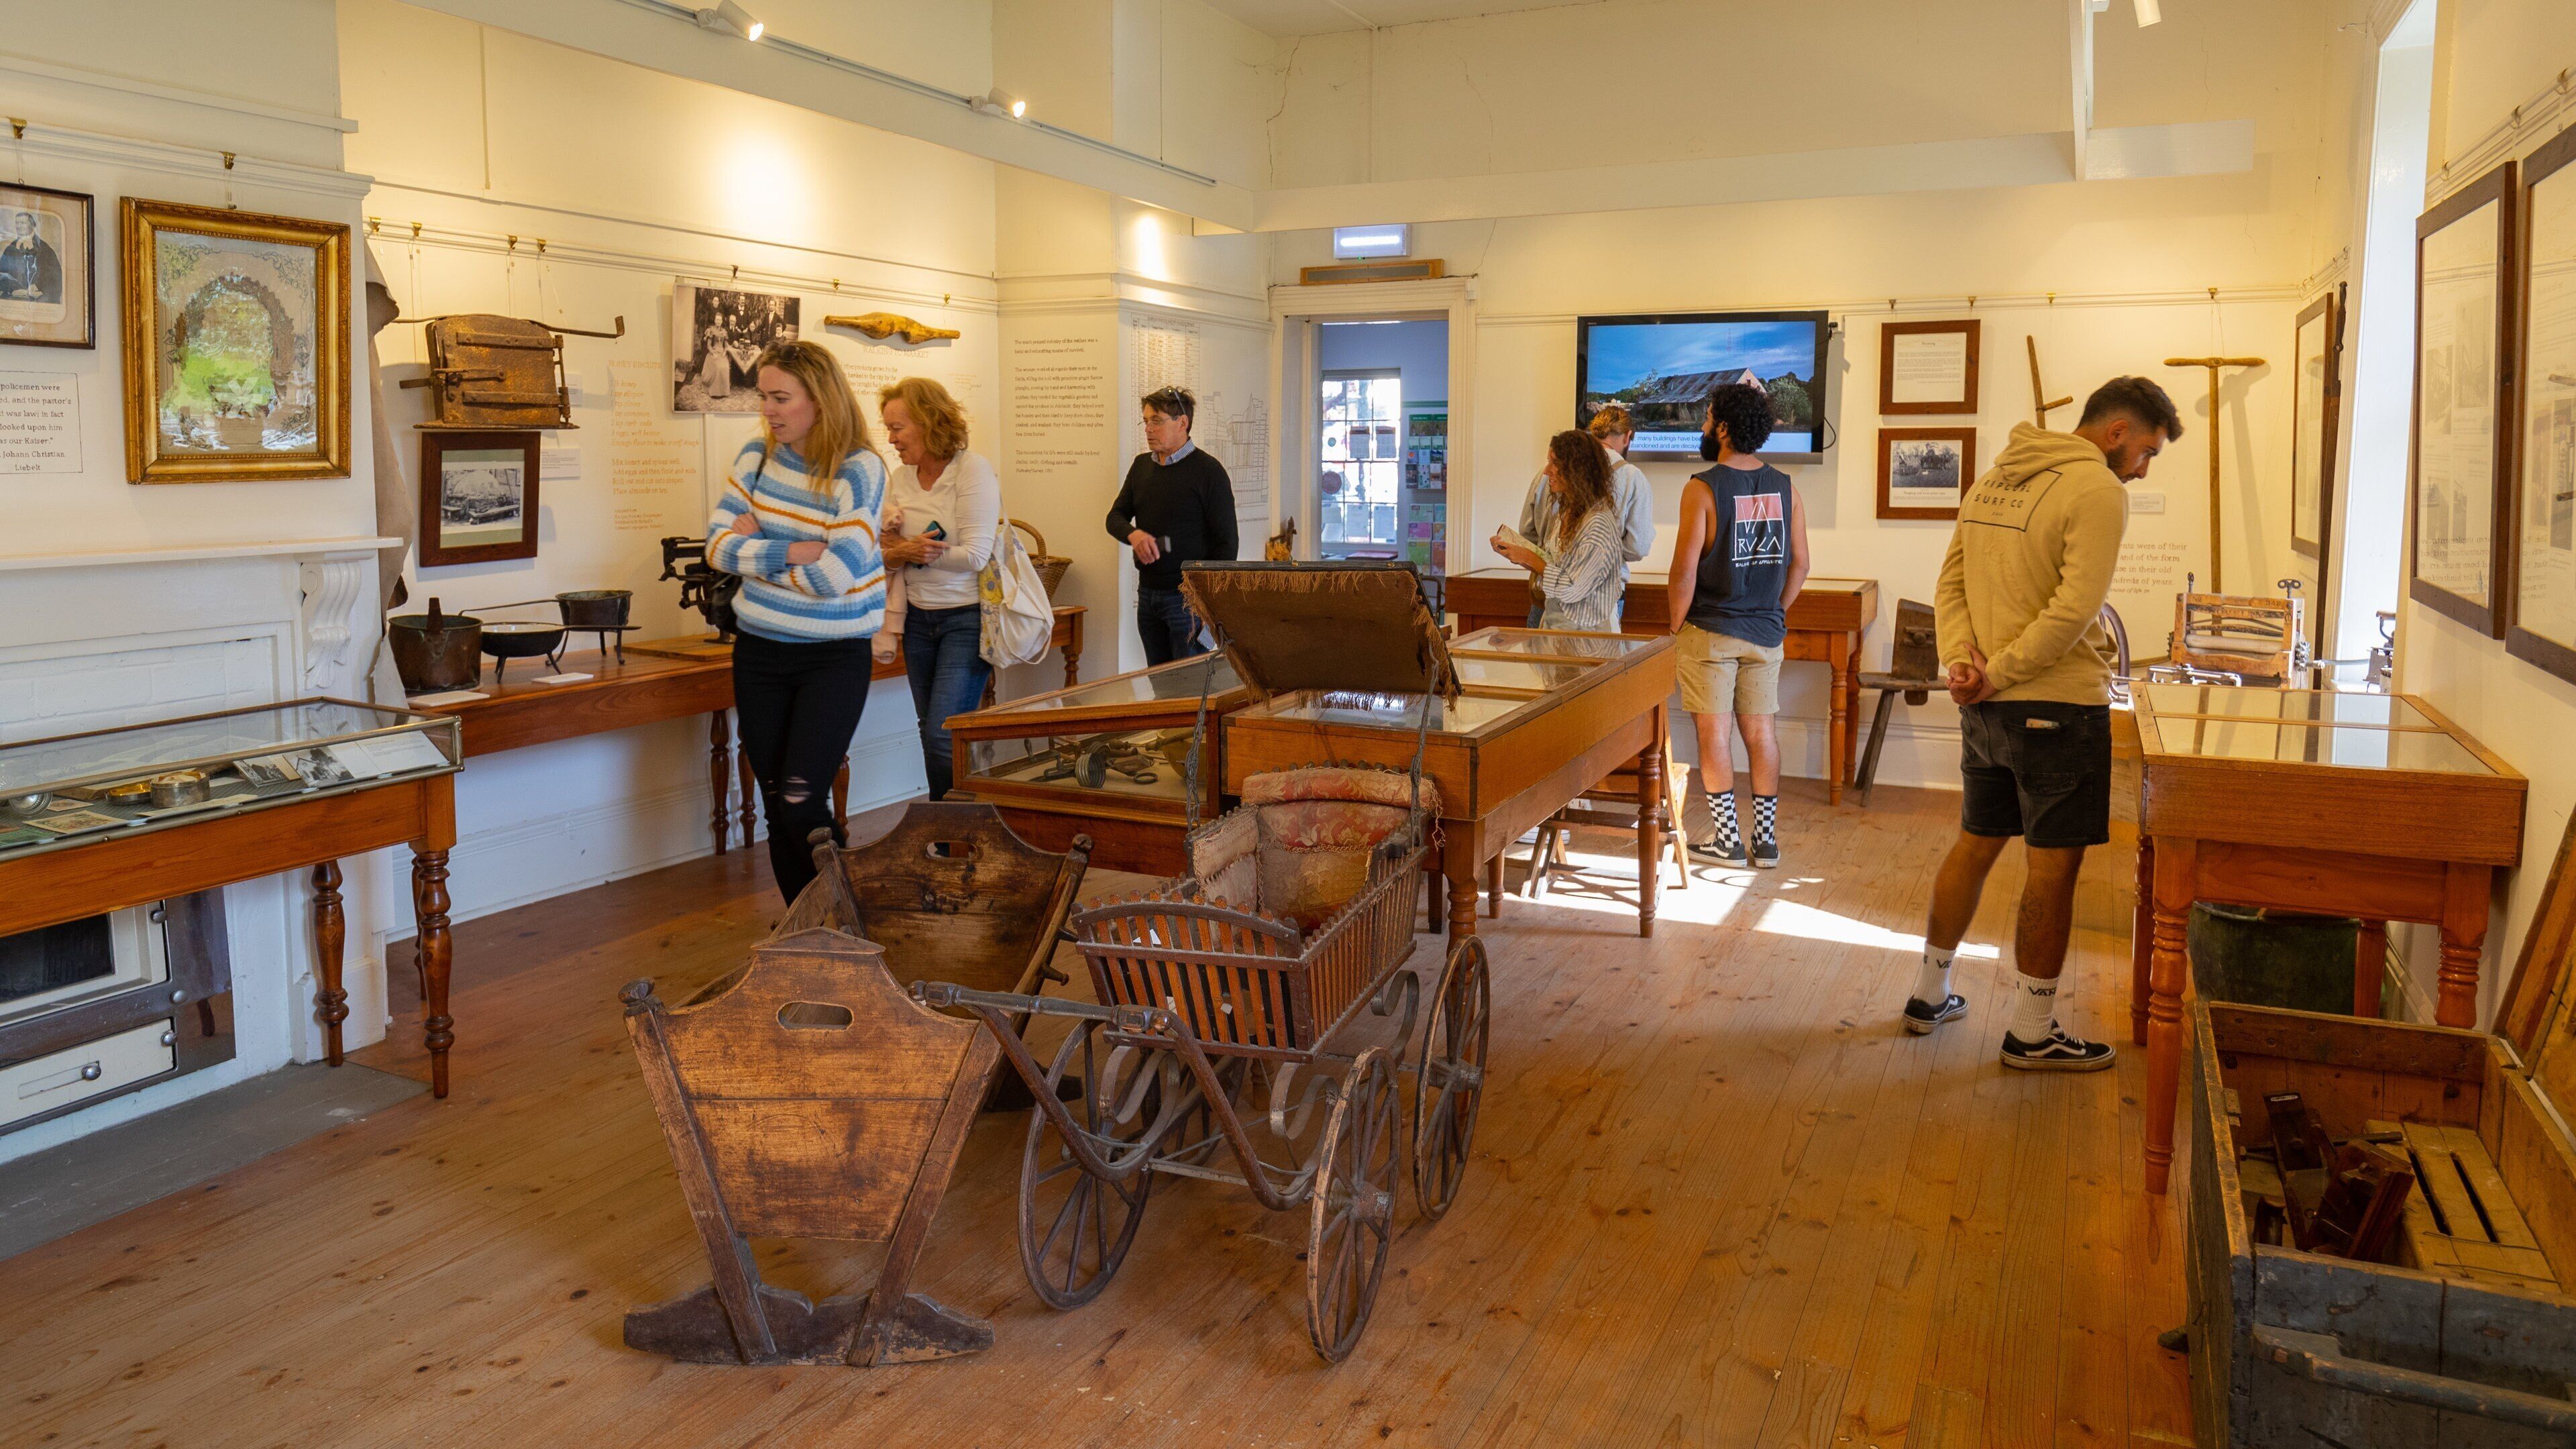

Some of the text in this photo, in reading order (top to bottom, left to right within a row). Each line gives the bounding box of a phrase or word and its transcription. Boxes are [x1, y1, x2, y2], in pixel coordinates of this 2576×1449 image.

[1, 383, 40, 391] policemen
[3, 451, 30, 459] Johann
[1974, 494, 2023, 508] SURF CO
[1737, 535, 1781, 554] RVCA
[2161, 554, 2180, 562] form
[2141, 577, 2151, 585] of
[1937, 959, 1952, 969] VA
[2028, 986, 2057, 996] VAN
